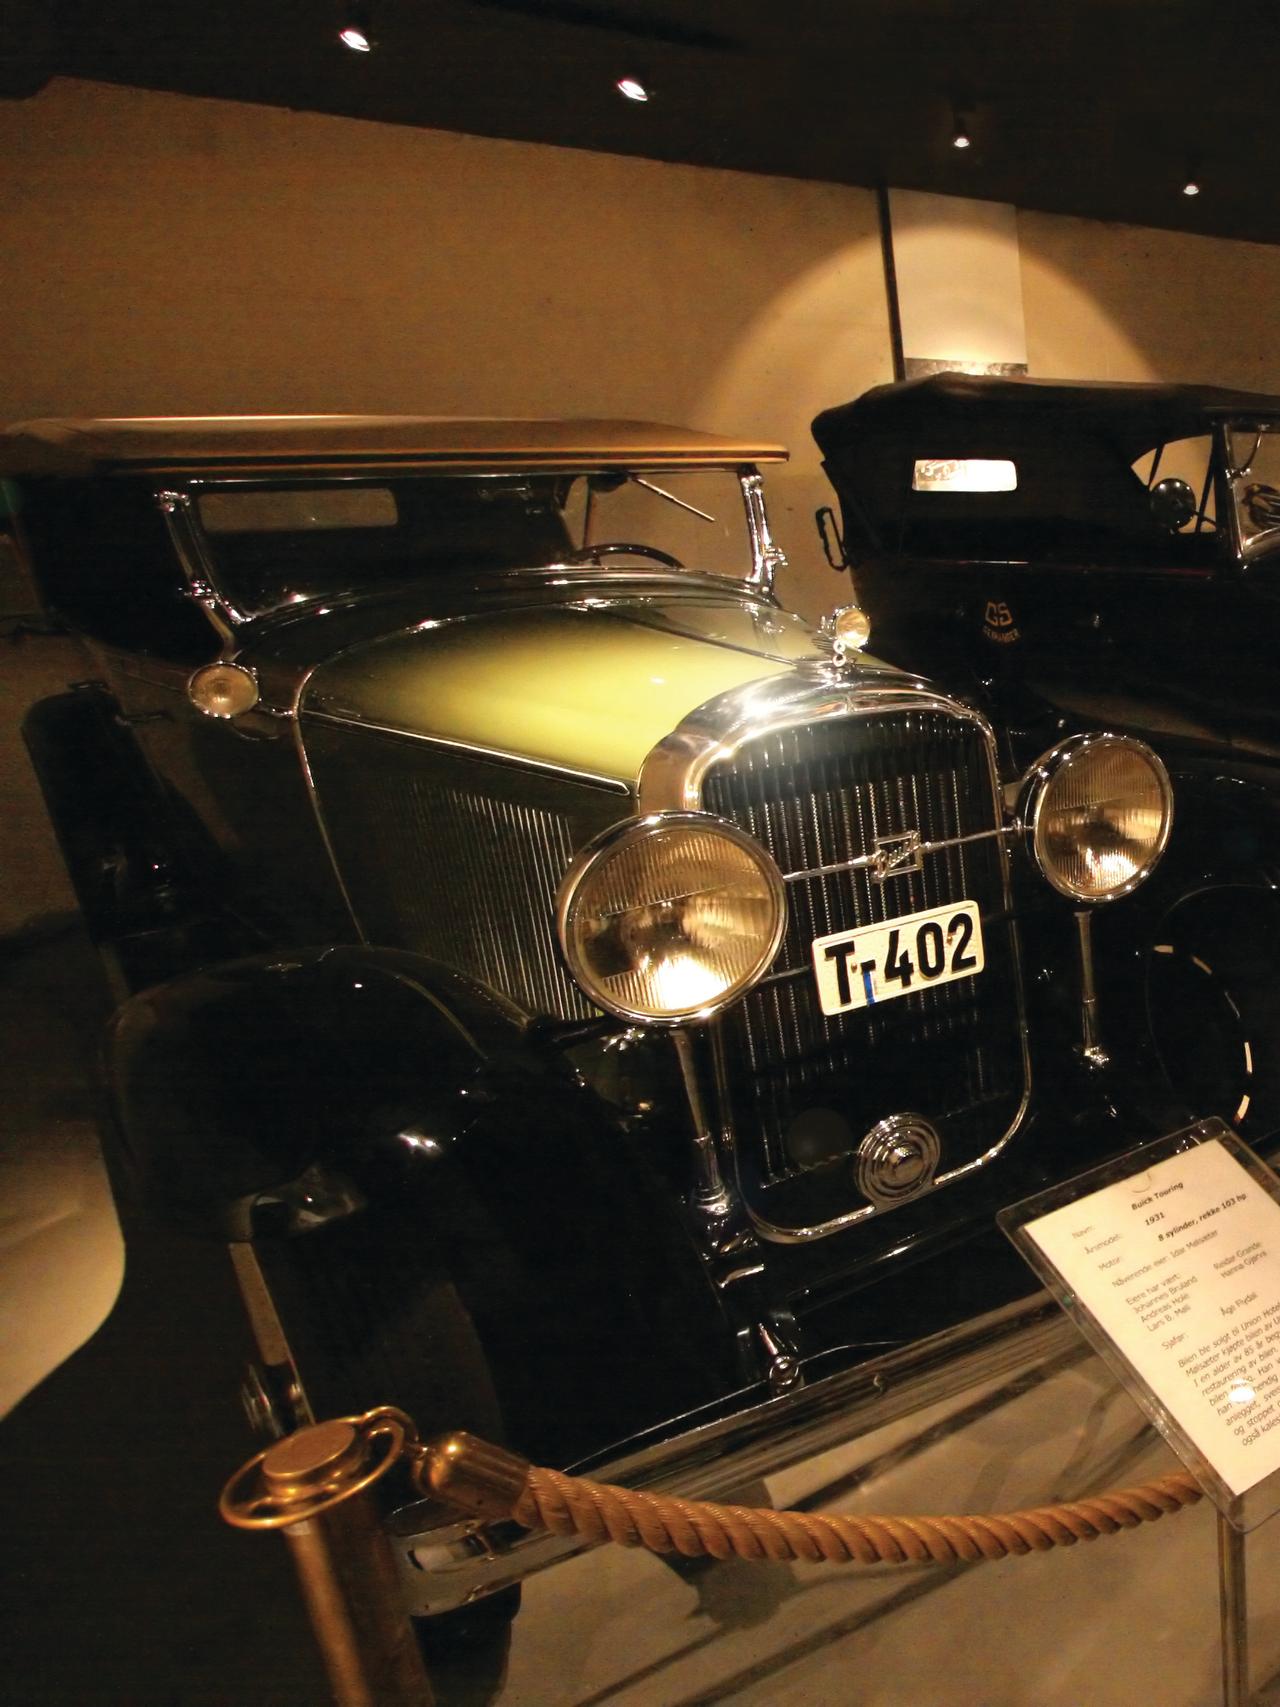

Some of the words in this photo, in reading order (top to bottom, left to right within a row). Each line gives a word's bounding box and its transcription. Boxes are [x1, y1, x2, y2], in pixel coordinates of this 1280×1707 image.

[1131, 1197, 1153, 1210] Buick
[1154, 1182, 1184, 1199] Touring
[1145, 1212, 1165, 1226] 1931
[1165, 1220, 1198, 1238] sylinder,
[1199, 1207, 1220, 1221] rekke
[1221, 1198, 1236, 1209] 103
[1146, 1284, 1159, 1294] har
[1140, 1303, 1172, 1323] Andreas
[1146, 1320, 1165, 1332] Lars
[1177, 1353, 1197, 1368] Bilen
[1198, 1345, 1211, 1356] ble
[1212, 1333, 1231, 1348] solgt
[1240, 1315, 1262, 1331] Union
[1262, 1301, 1280, 1318] Hotel
[1221, 1339, 1244, 1356] kjøpte
[1245, 1328, 1263, 1342] bilen
[1213, 1360, 1230, 1376] alder
[1209, 1391, 1228, 1407] bilen
[1257, 1363, 1273, 1376] Han
[1246, 1404, 1275, 1427] stoppet
